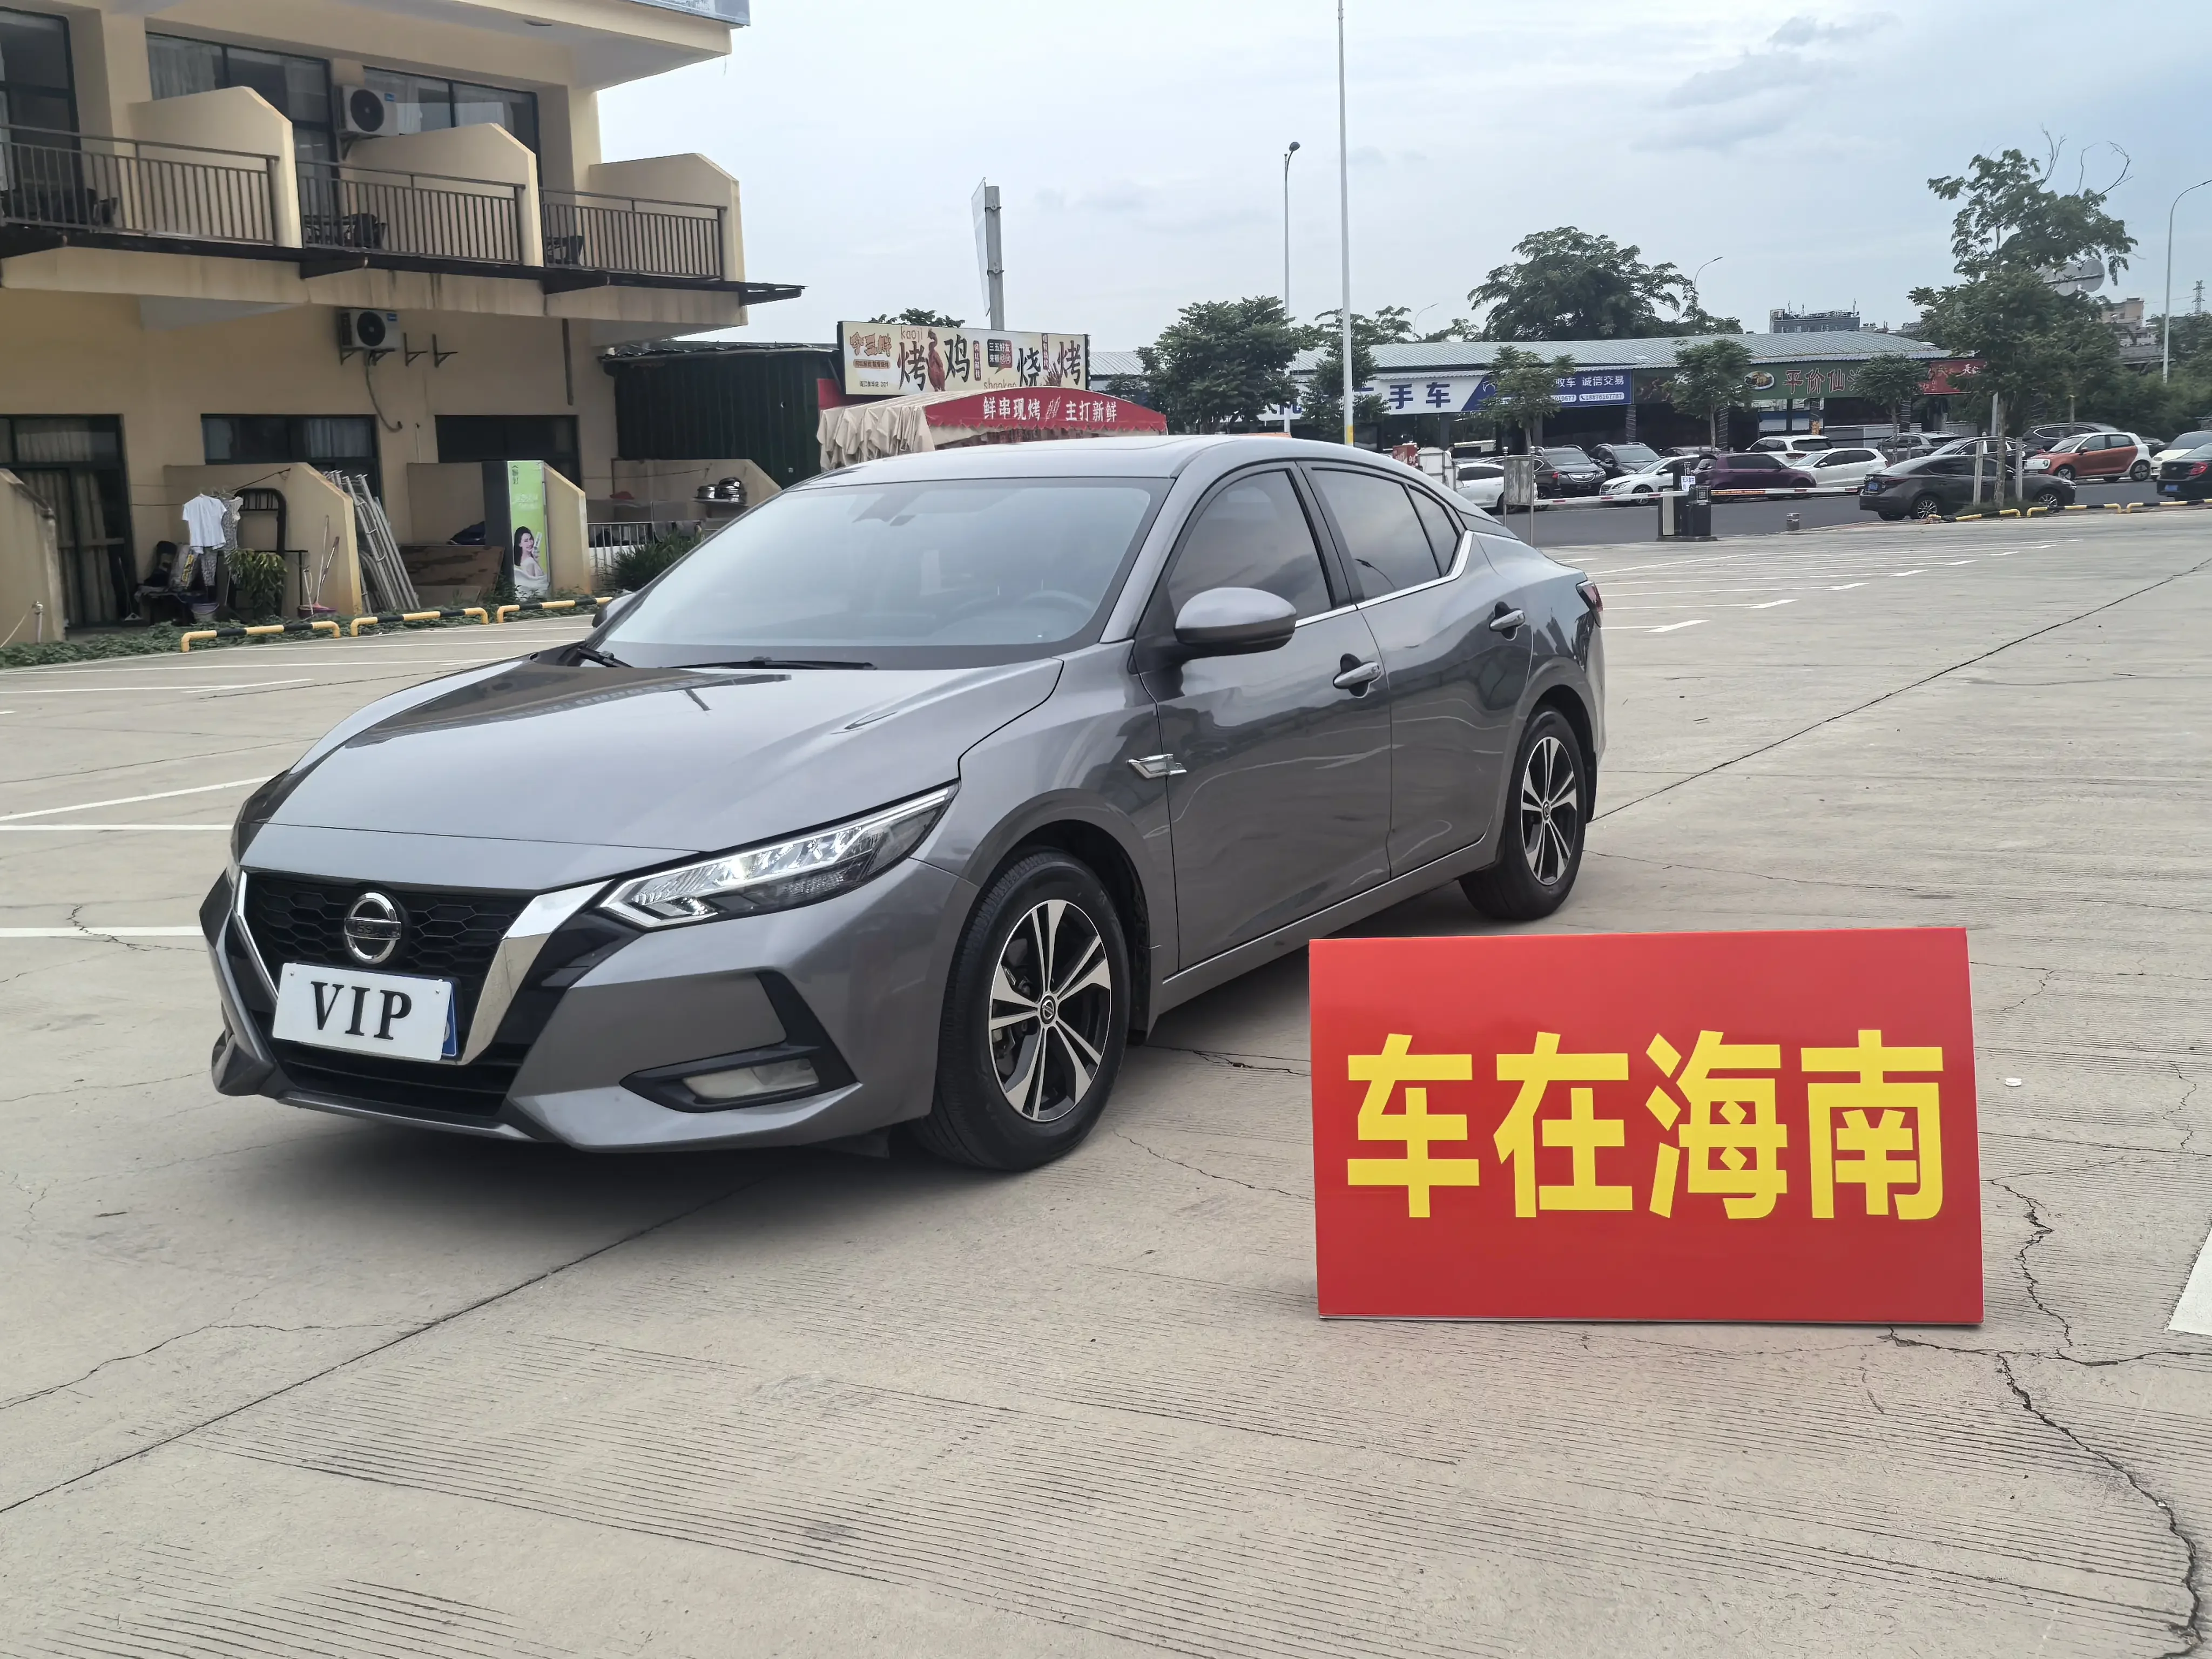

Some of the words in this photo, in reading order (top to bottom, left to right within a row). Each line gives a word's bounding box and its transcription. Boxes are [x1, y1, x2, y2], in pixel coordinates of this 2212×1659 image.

[1582, 375, 1624, 387] 诚信交易
[983, 396, 1041, 422] 鲜串现烤
[1065, 400, 1117, 423] 主打新鲜
[311, 981, 413, 1040] VIP
[1347, 1029, 1944, 1220] 车在海南
